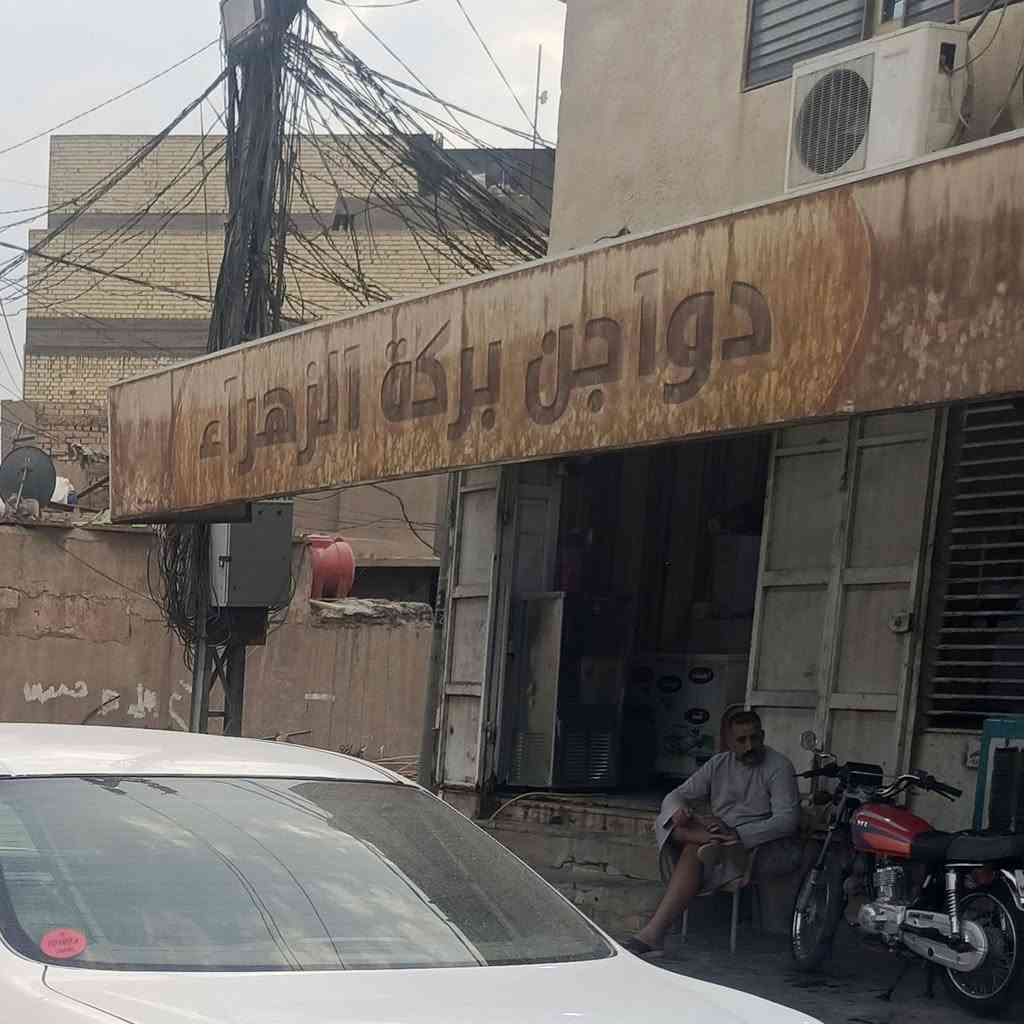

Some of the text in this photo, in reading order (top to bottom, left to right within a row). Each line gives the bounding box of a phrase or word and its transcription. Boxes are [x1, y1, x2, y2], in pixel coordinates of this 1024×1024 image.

[199, 268, 773, 476] دواجن بركة الزهراء
